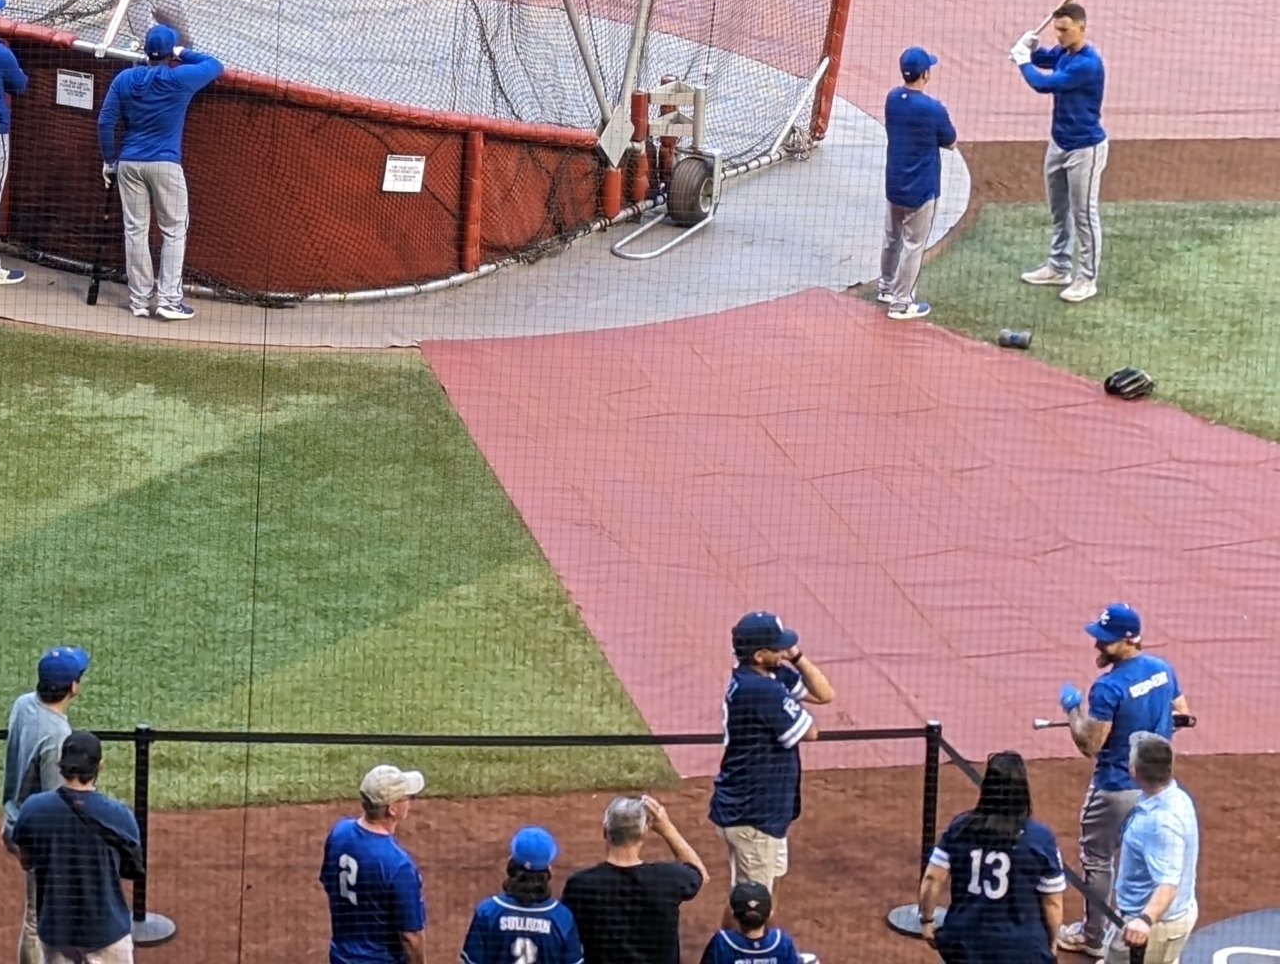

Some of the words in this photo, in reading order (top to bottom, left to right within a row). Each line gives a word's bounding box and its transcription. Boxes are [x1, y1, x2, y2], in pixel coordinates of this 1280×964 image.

[338, 852, 359, 906] 2
[966, 847, 1012, 900] 13
[499, 916, 552, 935] SULLIVAN
